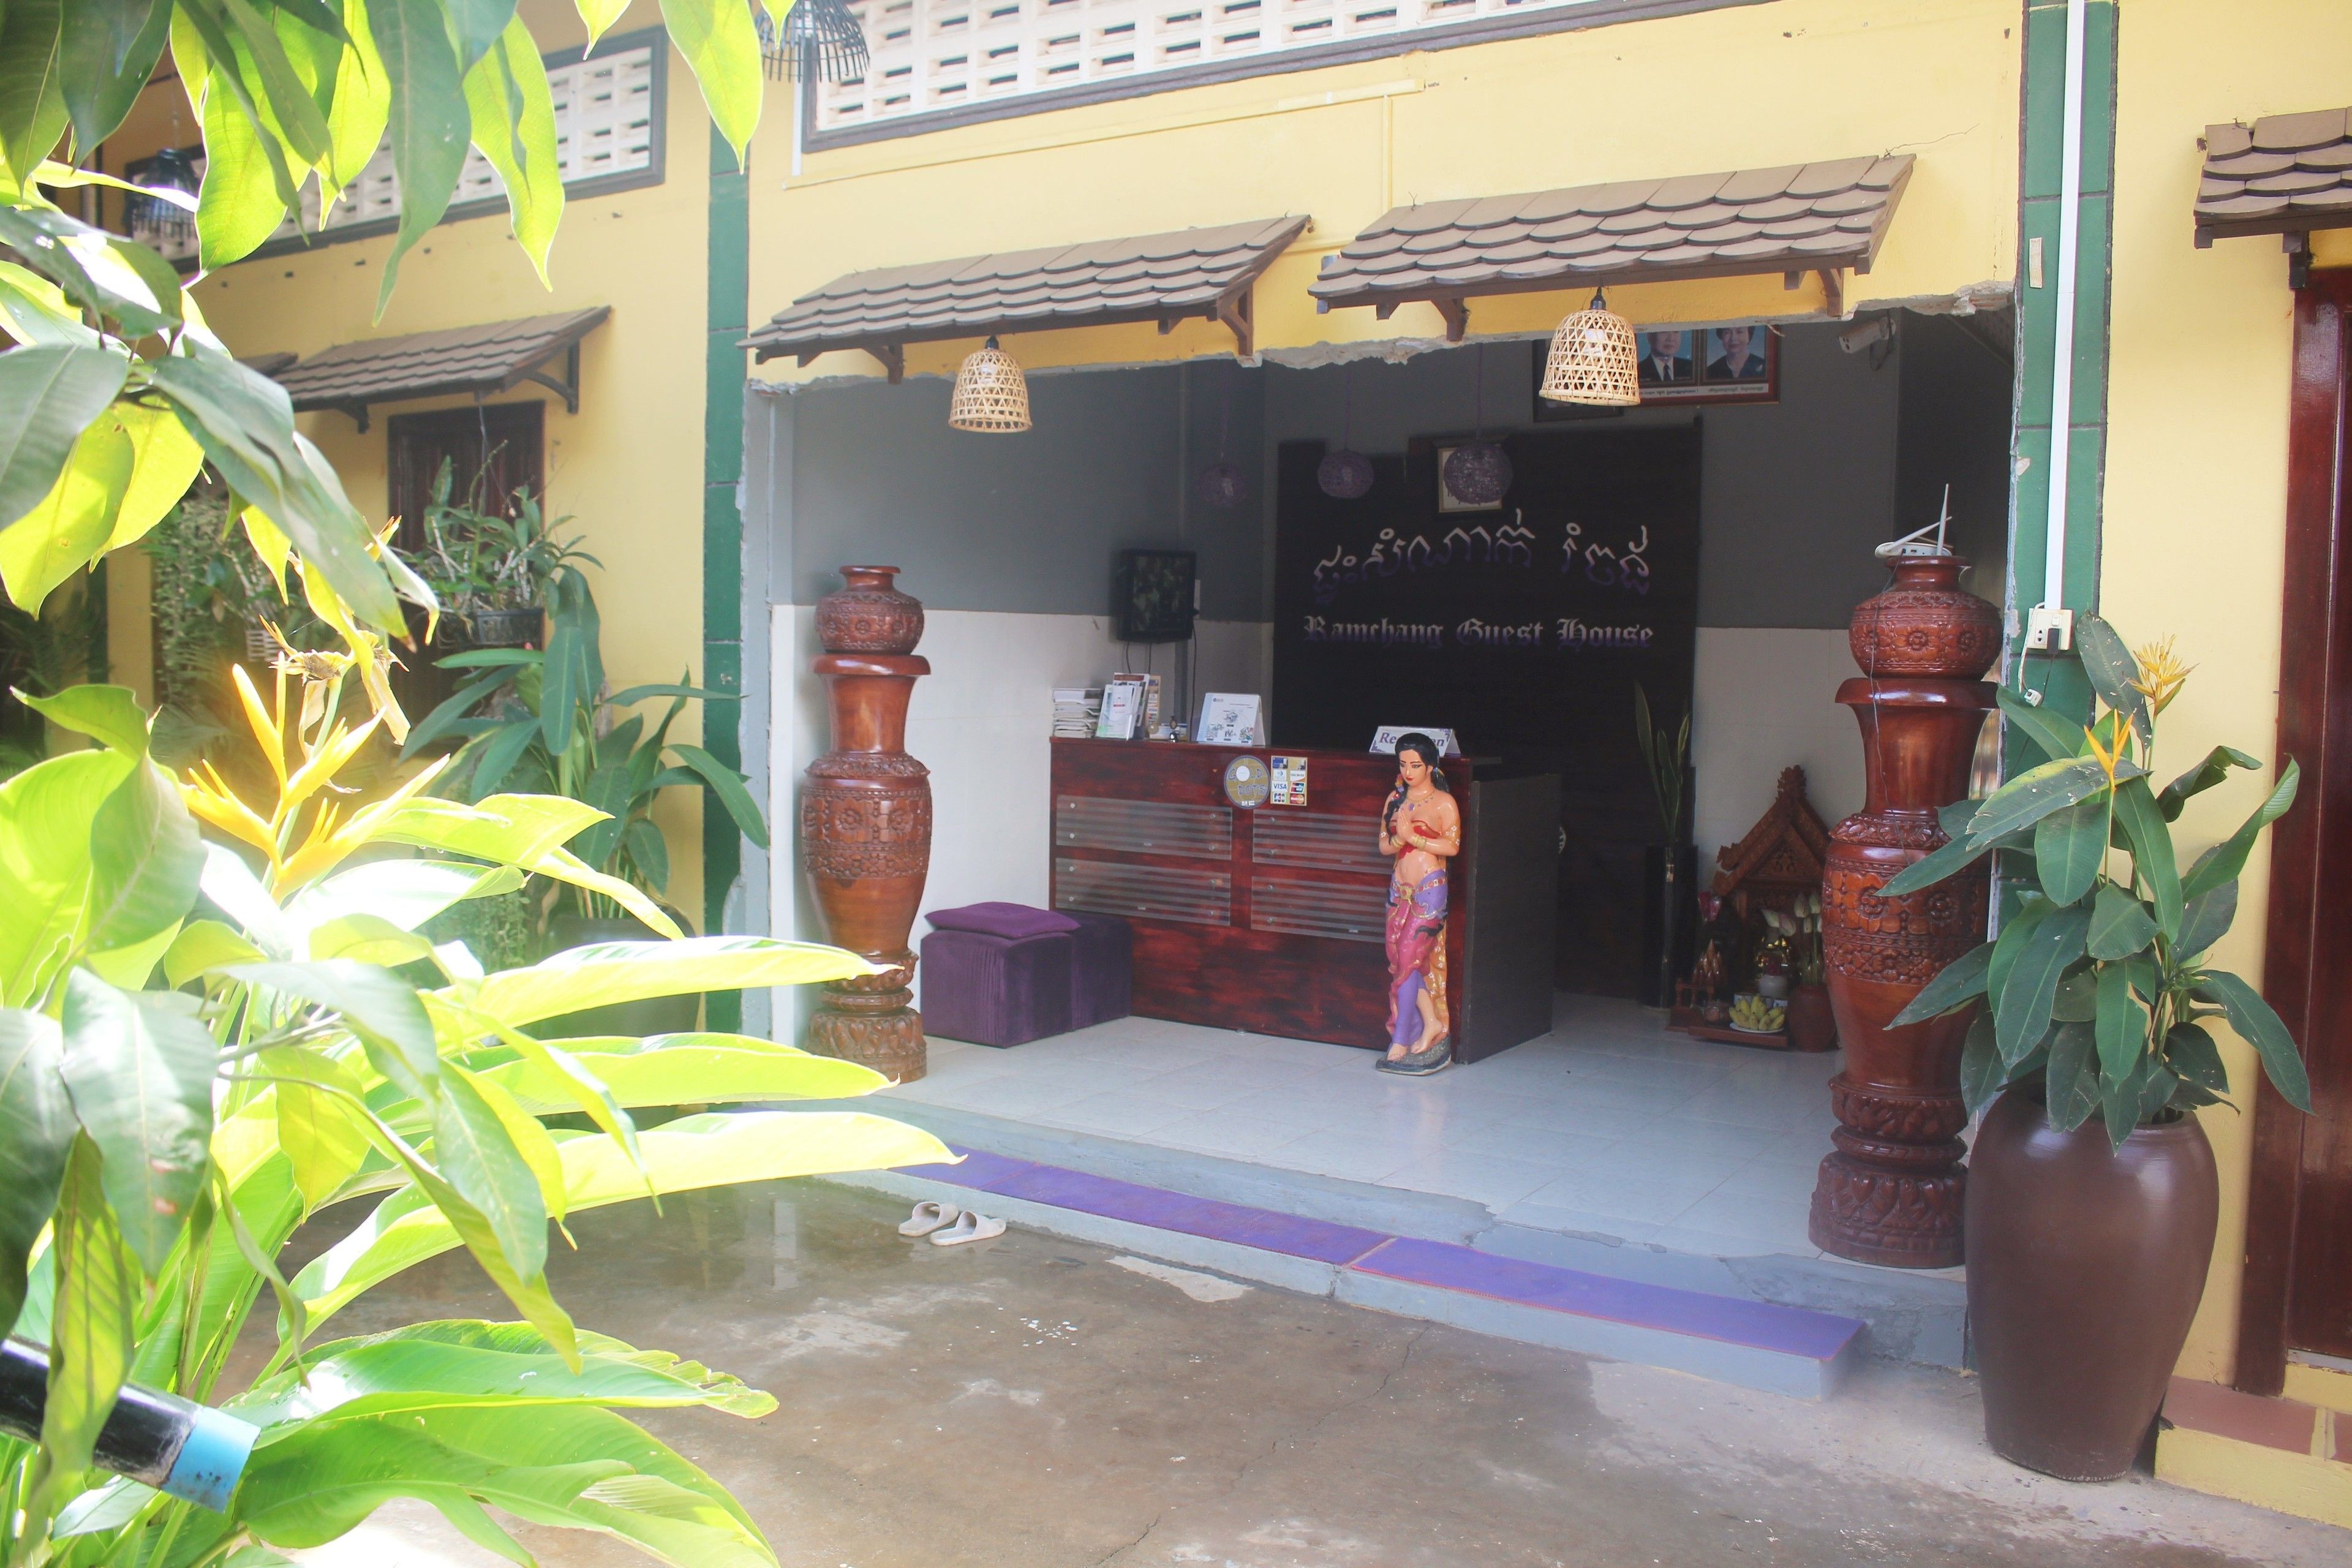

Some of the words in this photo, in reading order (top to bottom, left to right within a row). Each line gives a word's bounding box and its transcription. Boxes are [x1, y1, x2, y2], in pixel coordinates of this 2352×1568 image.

[1303, 615, 1444, 648] Ramchang
[1455, 617, 1544, 646] Guest
[1556, 617, 1654, 650] House
[1228, 767, 1262, 781] GLD
